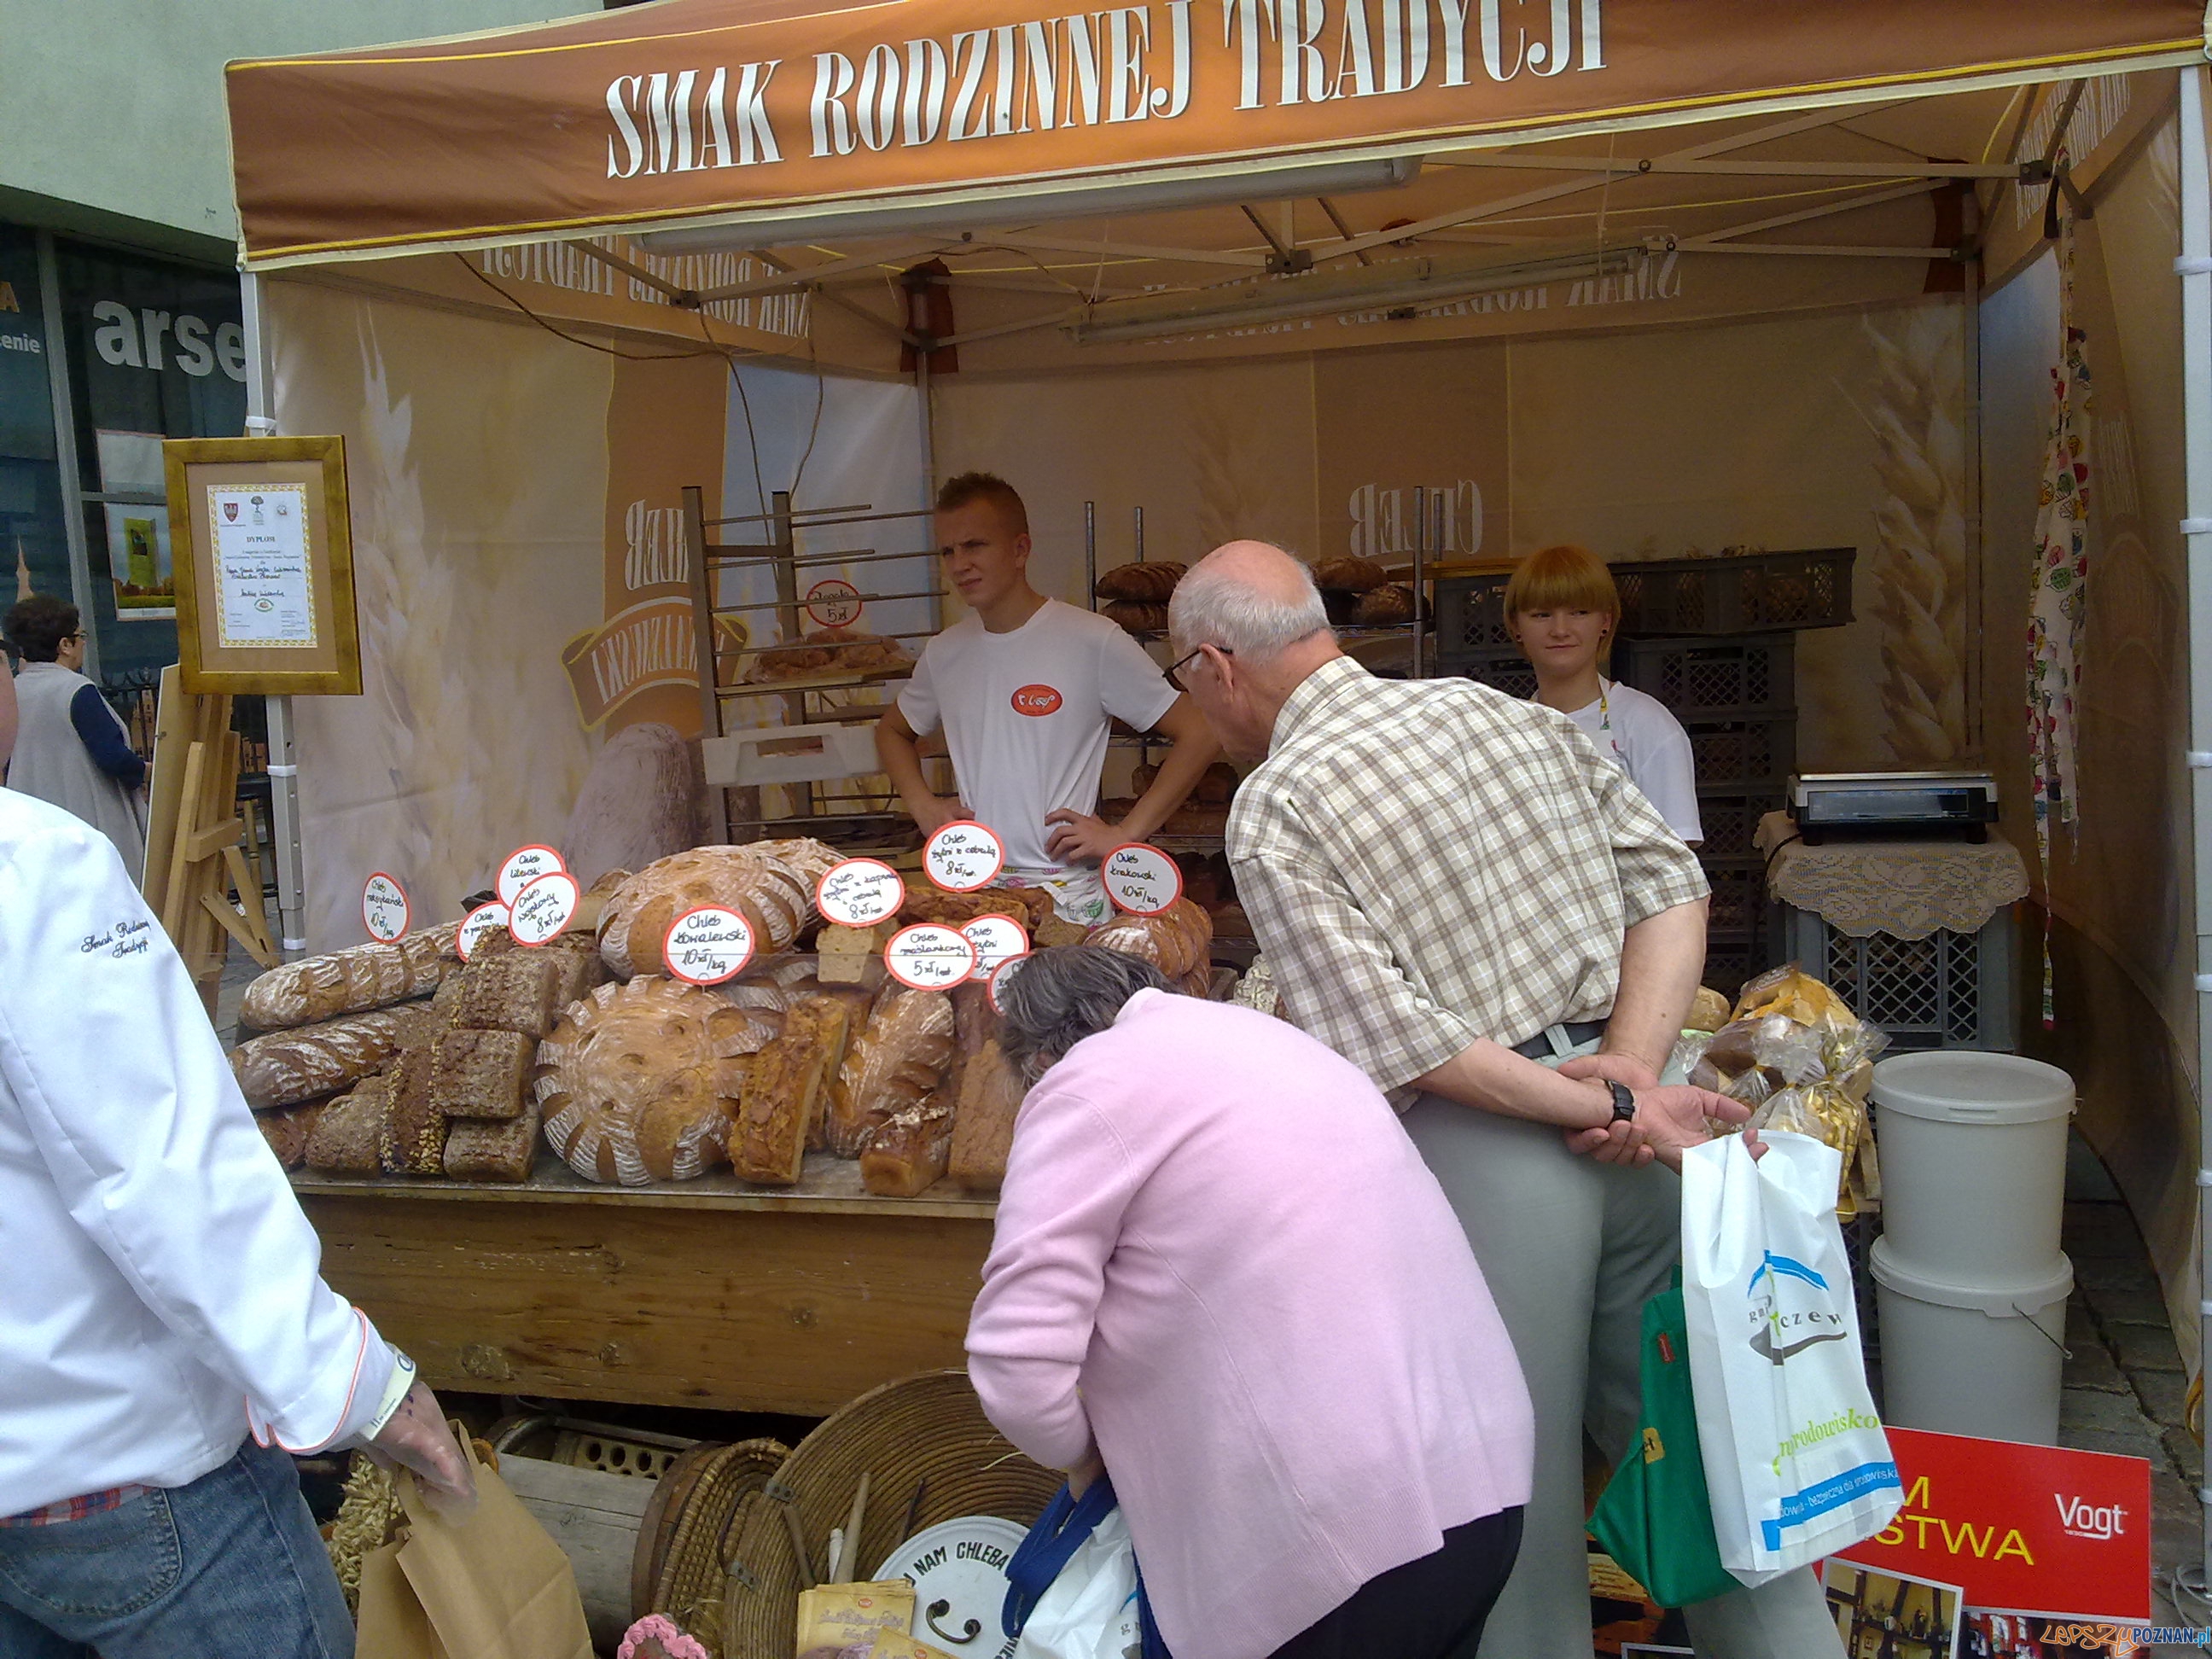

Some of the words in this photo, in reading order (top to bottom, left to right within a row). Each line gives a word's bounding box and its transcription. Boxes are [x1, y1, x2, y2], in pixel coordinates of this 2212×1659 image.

[606, 60, 784, 179] SMAK
[808, 0, 1192, 160] RODZINNEJ
[1223, 0, 1607, 111] TRADYCJI
[2054, 1493, 2128, 1540] Vogt
[913, 1545, 947, 1576] NAM
[956, 1541, 1010, 1571] CHLEBA
